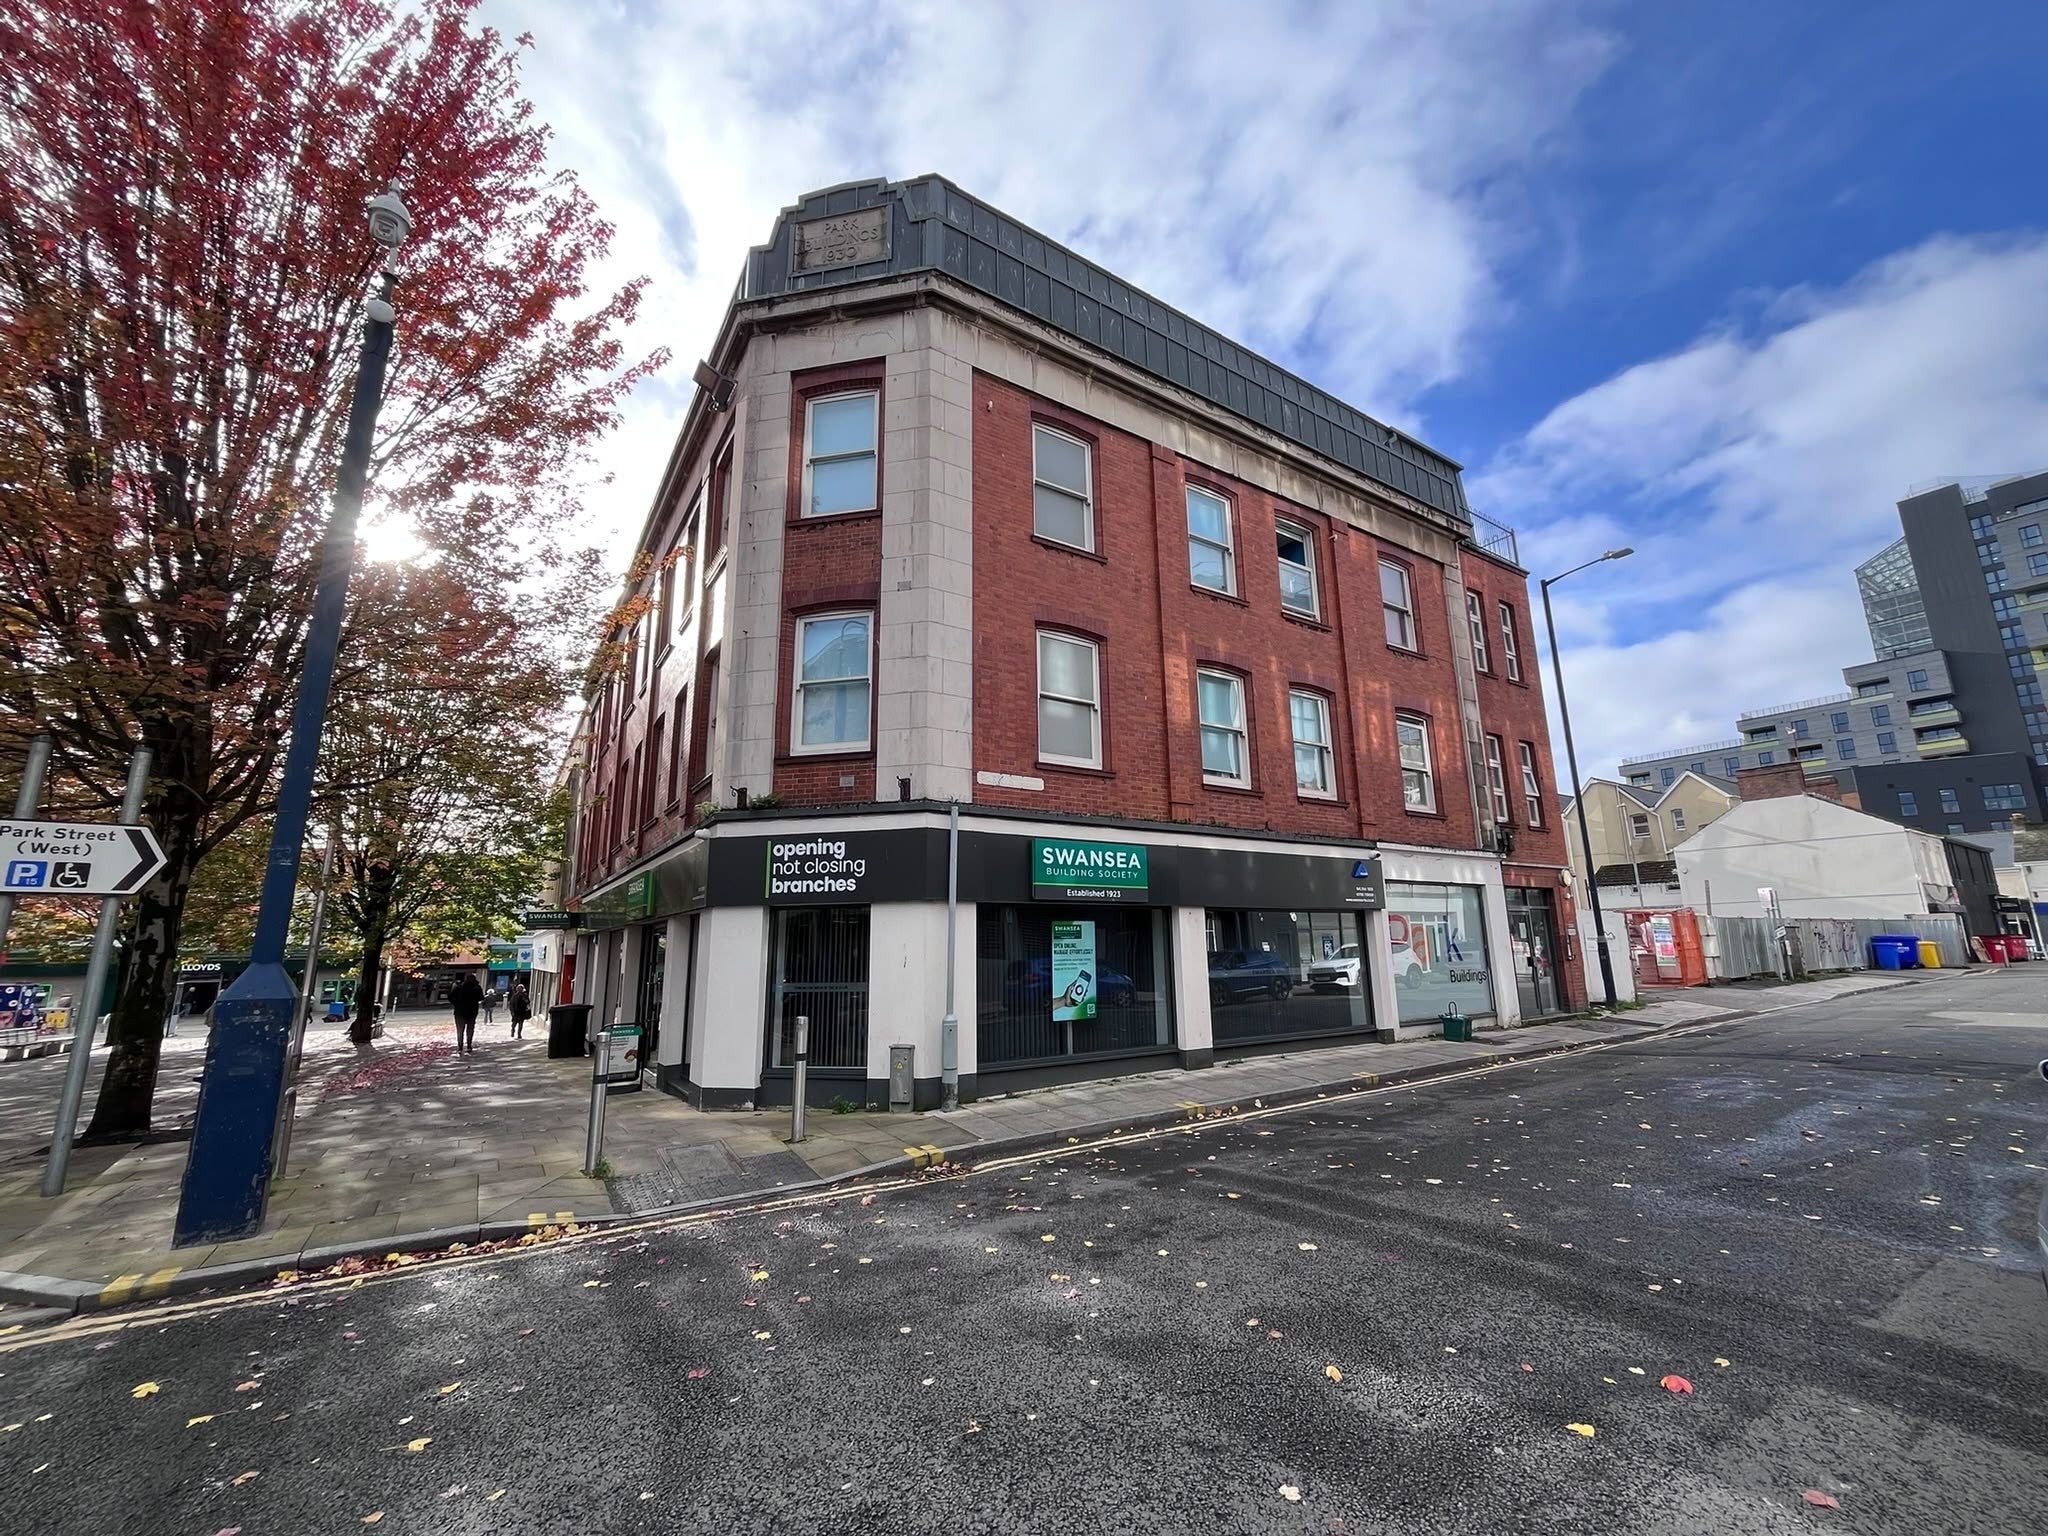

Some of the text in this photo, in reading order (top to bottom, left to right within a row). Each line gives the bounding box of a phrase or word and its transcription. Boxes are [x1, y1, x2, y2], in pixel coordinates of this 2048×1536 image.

[823, 218, 859, 235] PARK
[806, 228, 879, 252] BUILDINGS
[0, 825, 116, 841] Park Street
[17, 840, 92, 857] (West)
[773, 838, 846, 861] opening
[1042, 847, 1141, 869] SWANSEA
[773, 858, 865, 877] not closing
[1046, 867, 1139, 879] BUILDING SOCIETY
[771, 876, 857, 894] branches
[1066, 888, 1121, 898] Established 1923
[1388, 914, 1463, 963] Park
[181, 963, 222, 971] LLOYDS
[1449, 969, 1488, 984] Buildings
